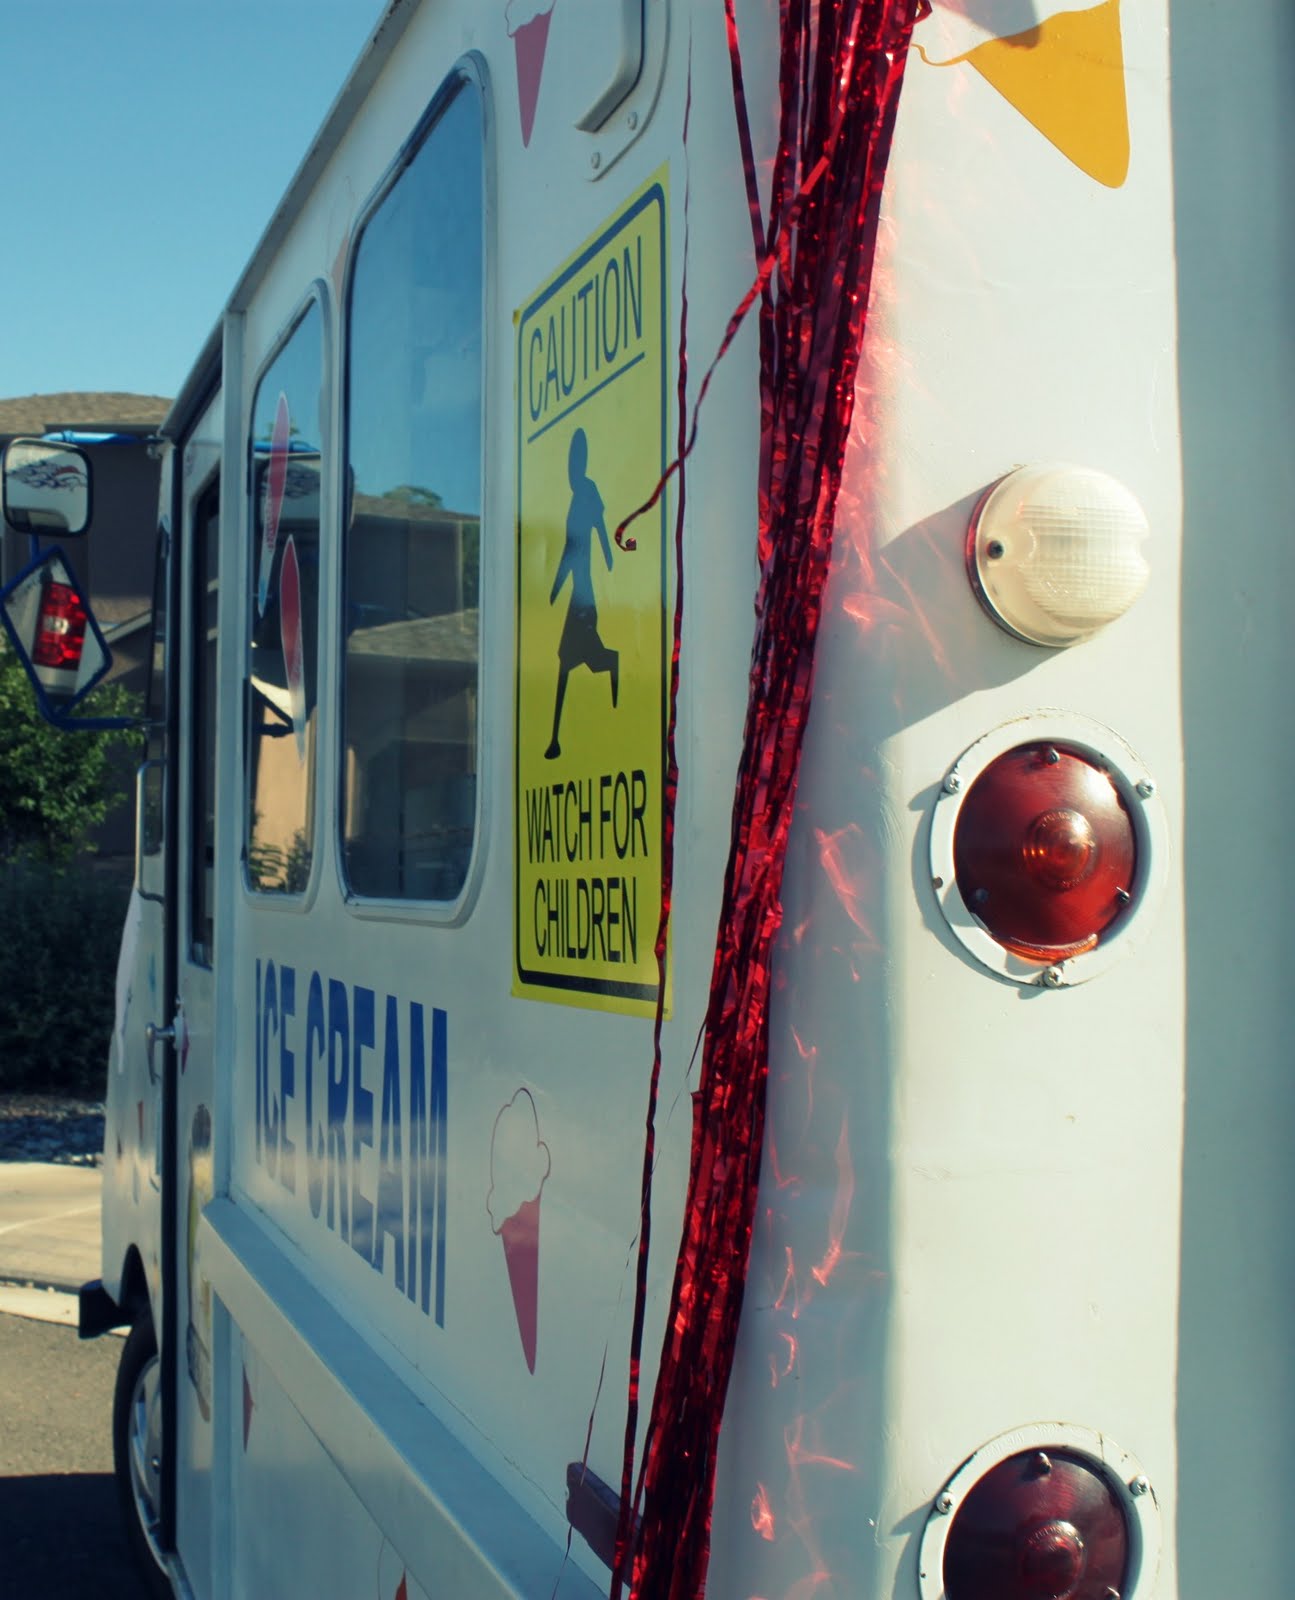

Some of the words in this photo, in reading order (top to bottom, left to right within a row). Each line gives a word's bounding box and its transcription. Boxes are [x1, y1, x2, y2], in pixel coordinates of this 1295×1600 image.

[528, 235, 642, 422] CAUTION
[525, 778, 592, 864] WATCH
[599, 769, 648, 860] FOR
[533, 876, 637, 965] CHILDREN
[255, 957, 296, 1197] ICE
[305, 970, 448, 1330] CREAM
